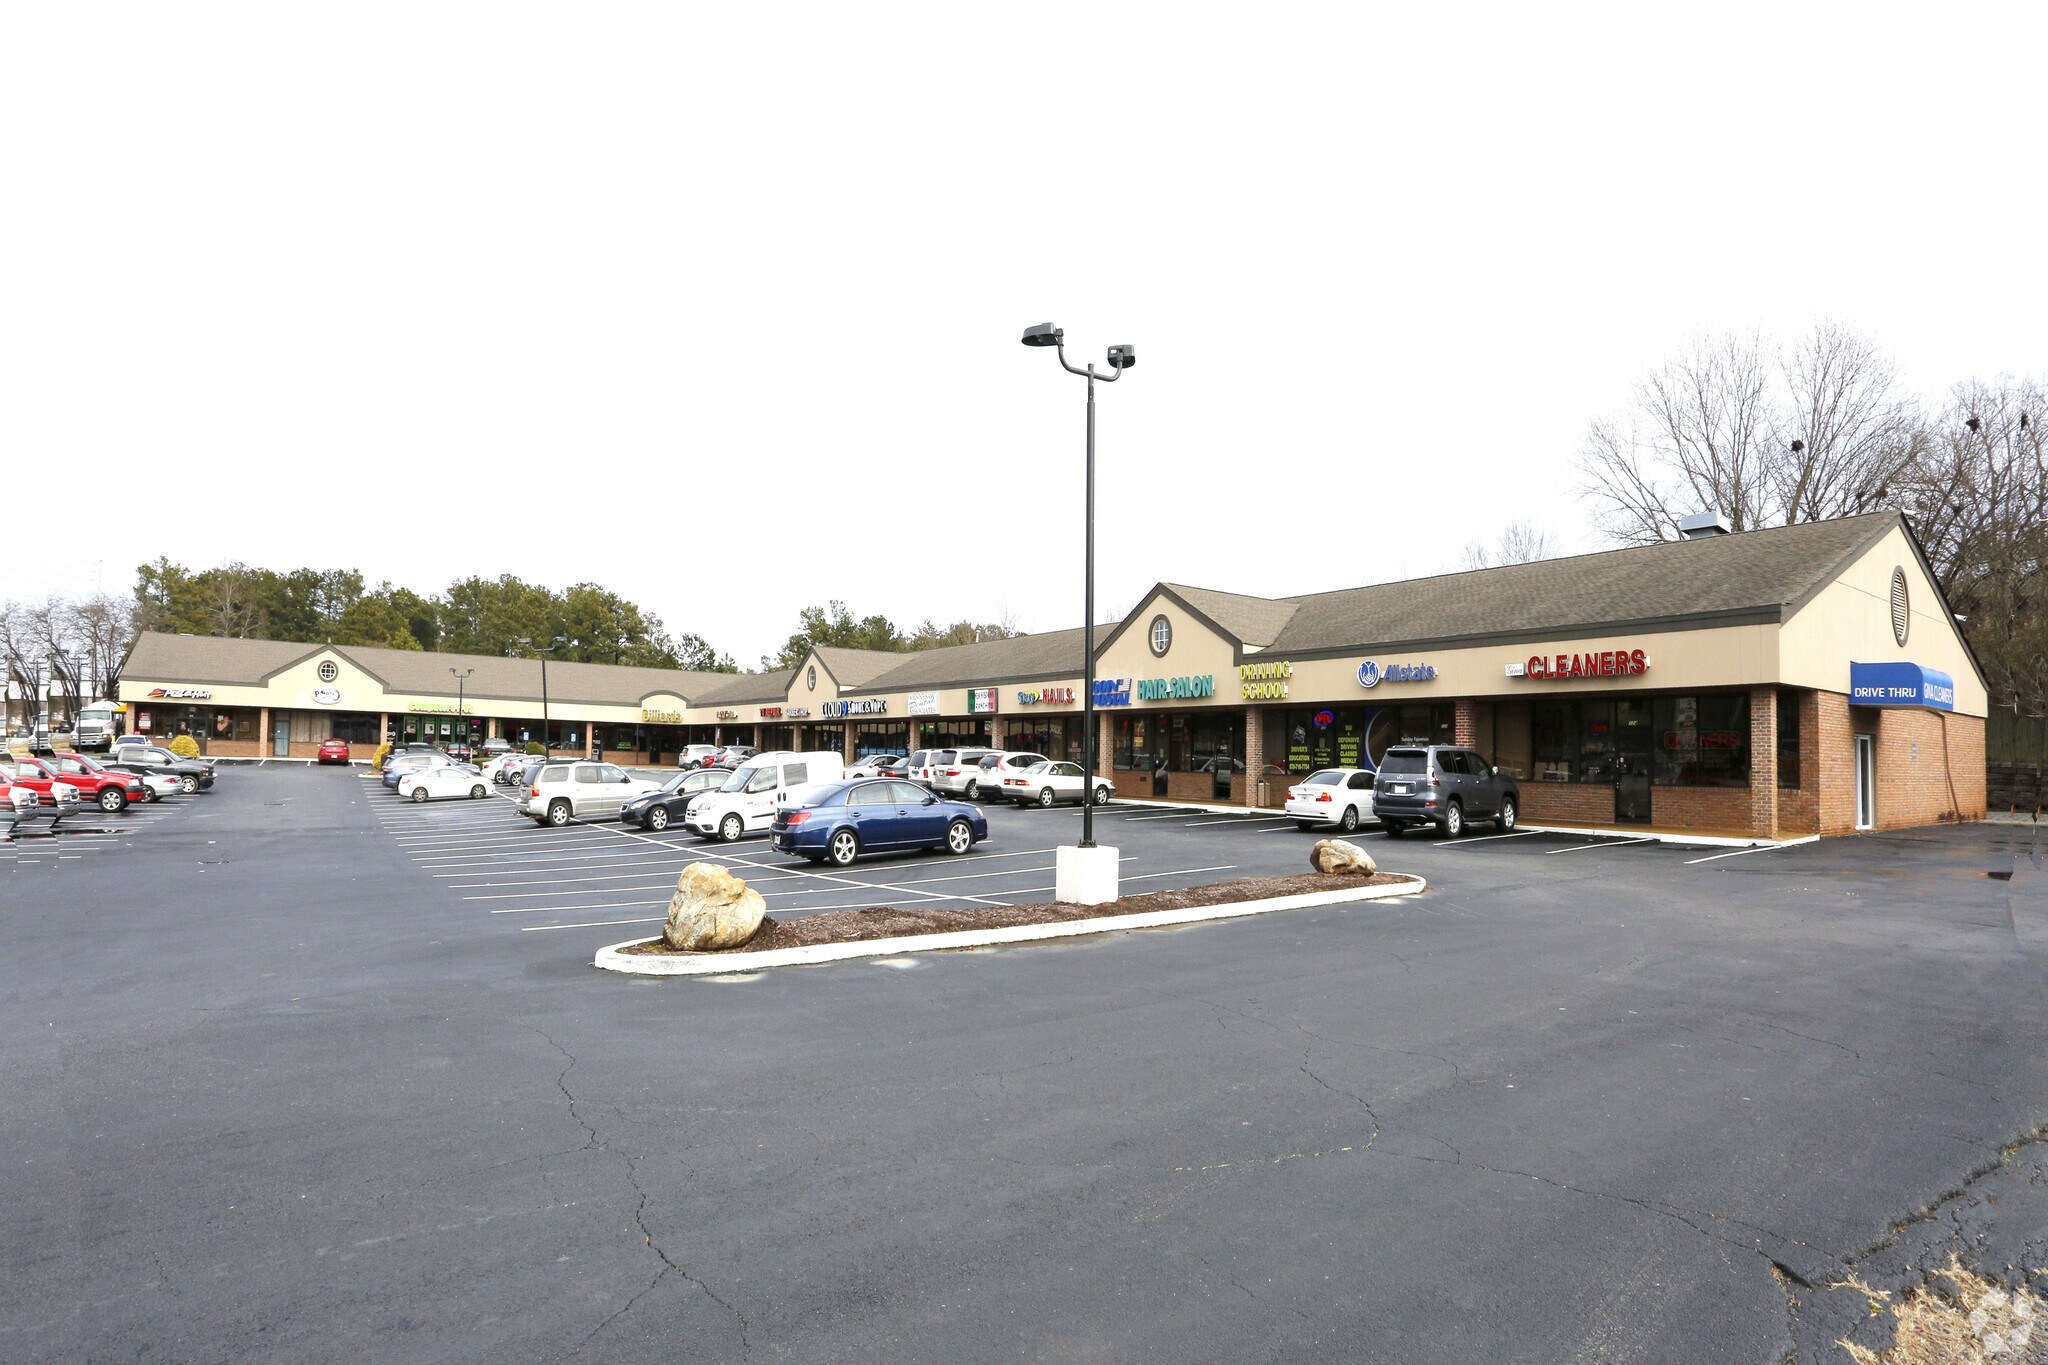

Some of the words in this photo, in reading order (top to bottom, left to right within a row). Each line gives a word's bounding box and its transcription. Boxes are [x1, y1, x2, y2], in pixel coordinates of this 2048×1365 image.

[1240, 661, 1290, 680] DRIVING
[1383, 663, 1434, 682] Allstate
[1527, 649, 1646, 679] CLEANERS
[1042, 687, 1072, 704] NAILS
[1137, 679, 1167, 700] HAIR
[1170, 675, 1213, 699] SALON
[1242, 682, 1287, 700] SCHOOL
[1854, 687, 1885, 698] DRIVE
[1888, 687, 1916, 698] THRU
[642, 709, 682, 723] Billiards
[822, 701, 842, 717] CLOUD
[841, 701, 848, 716] 9
